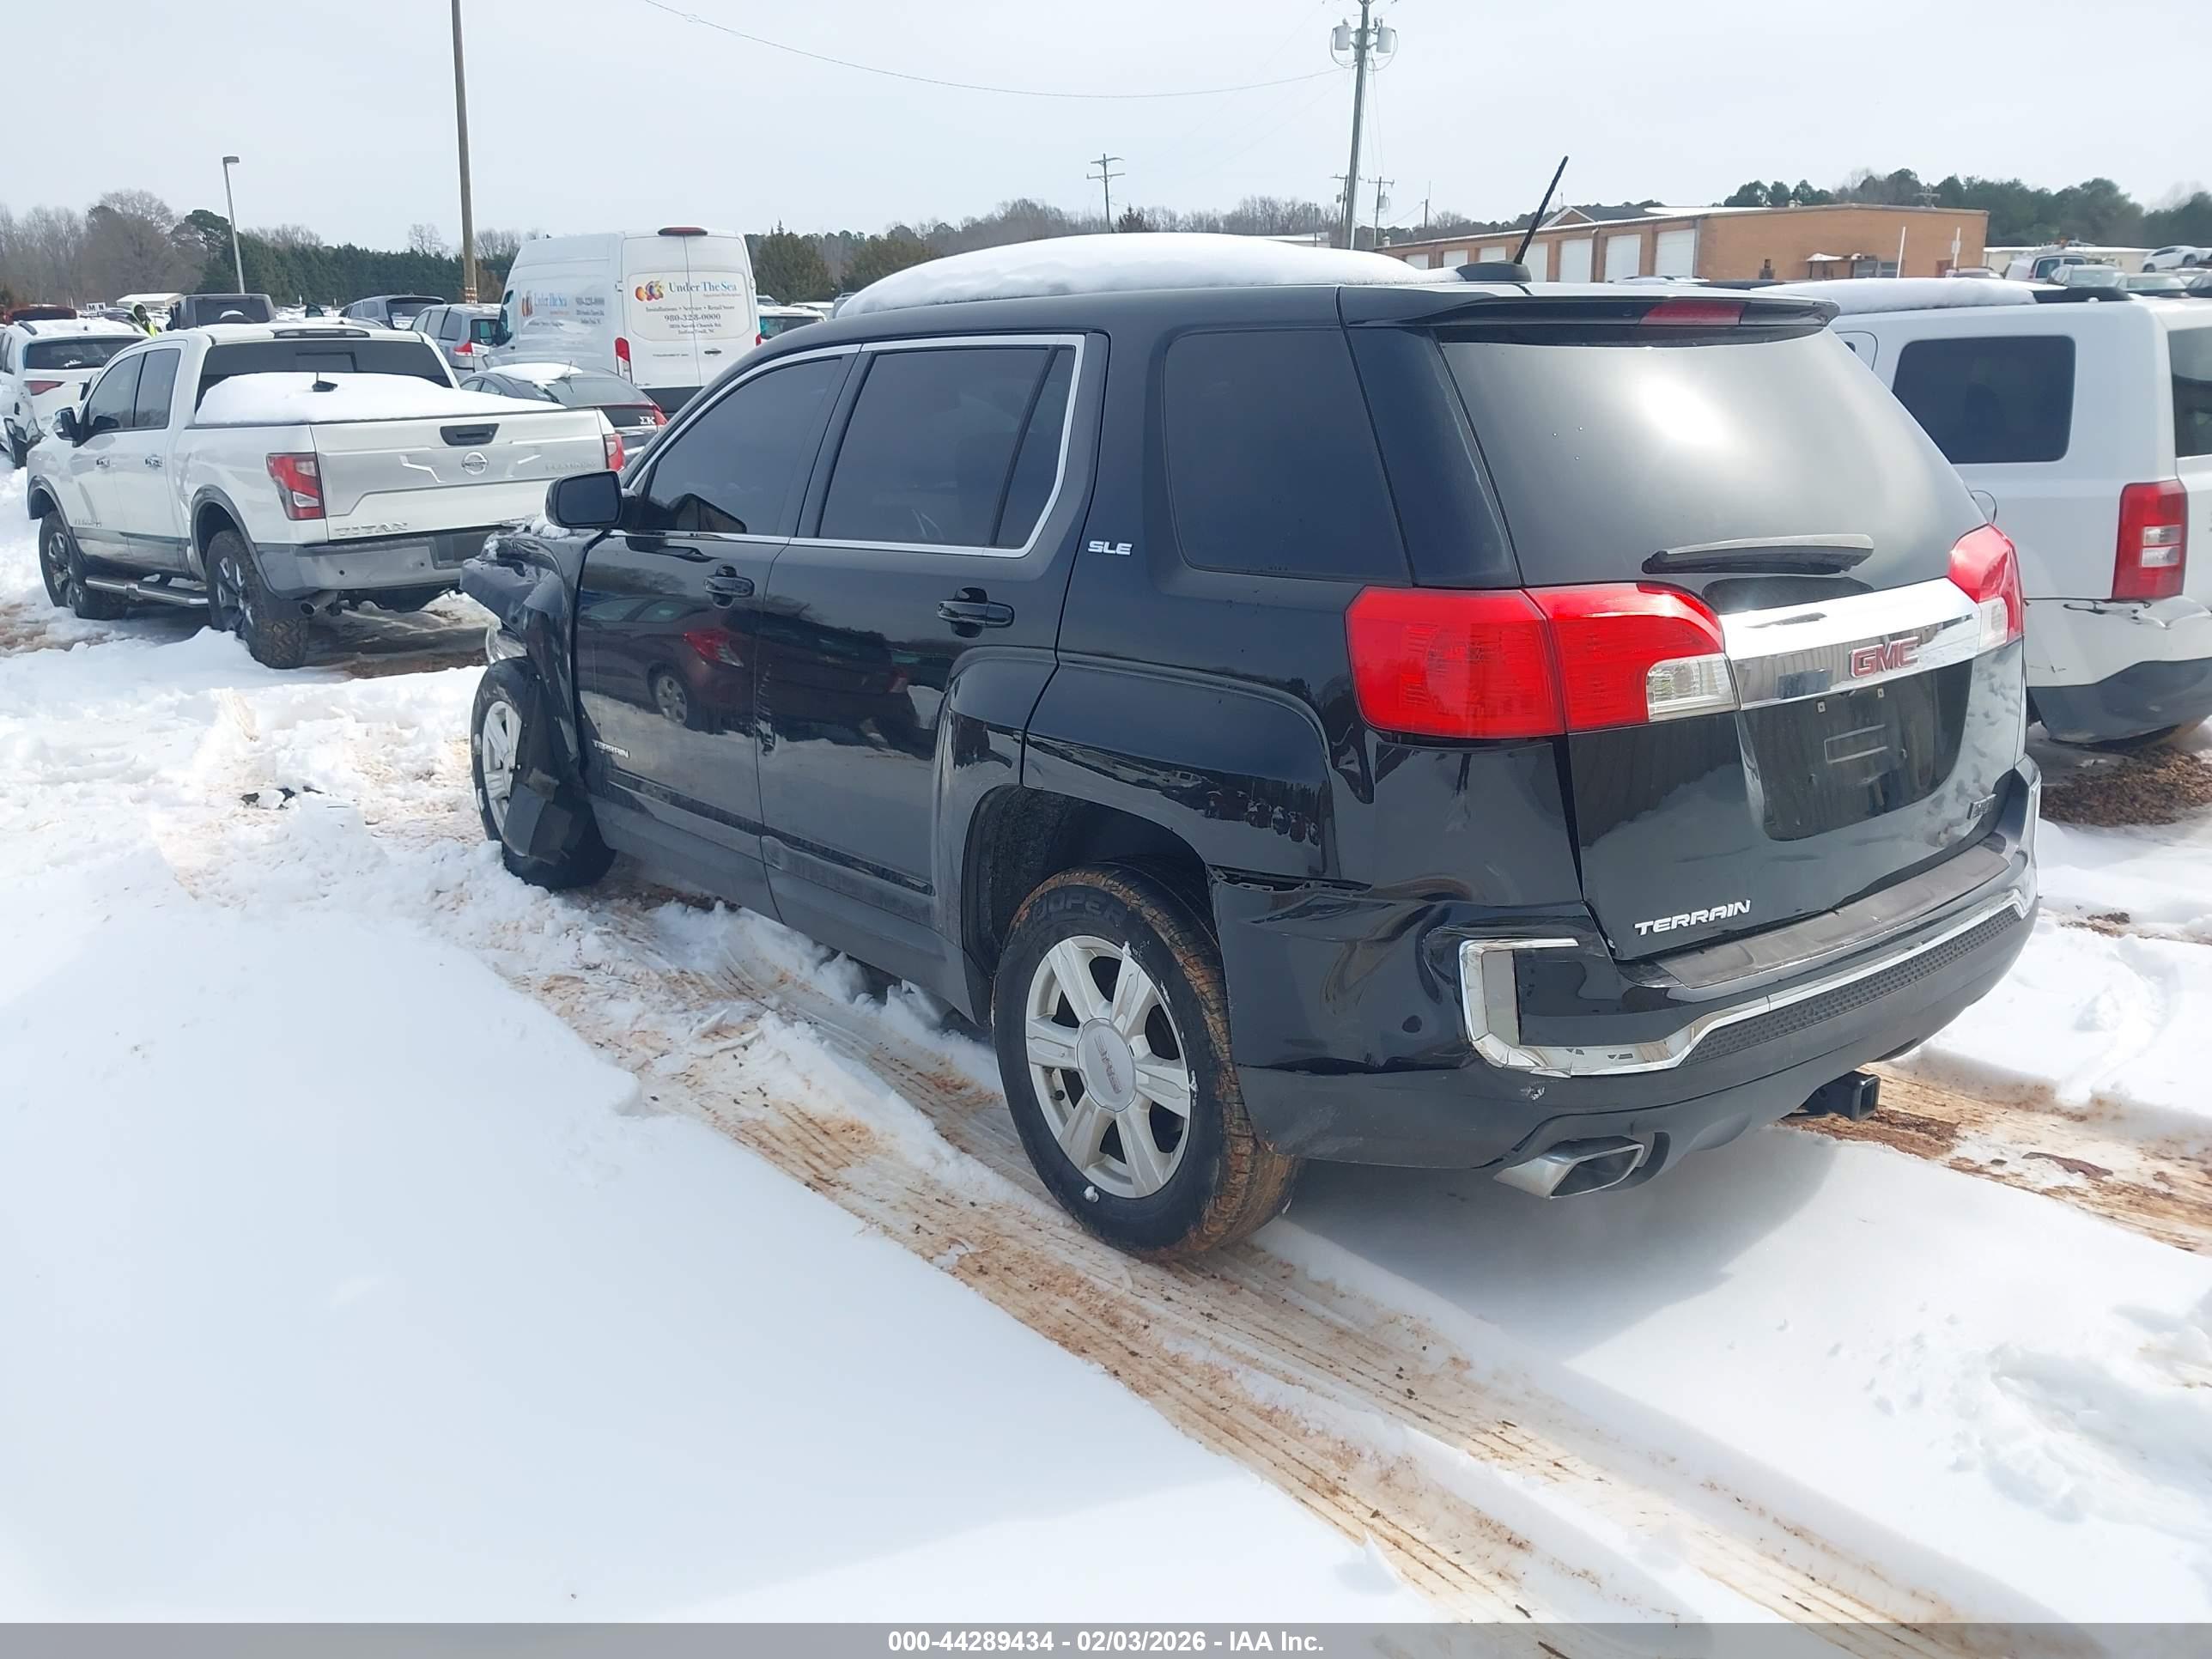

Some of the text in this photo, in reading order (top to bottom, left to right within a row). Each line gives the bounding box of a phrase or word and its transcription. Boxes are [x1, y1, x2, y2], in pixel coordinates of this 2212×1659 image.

[668, 281, 737, 293] Under The Sea
[334, 522, 409, 537] TITAN
[1087, 540, 1133, 556] SLE
[1850, 636, 1919, 678] GMC
[1026, 890, 1128, 925] OOPER
[1634, 899, 1751, 936] TERRAIN
